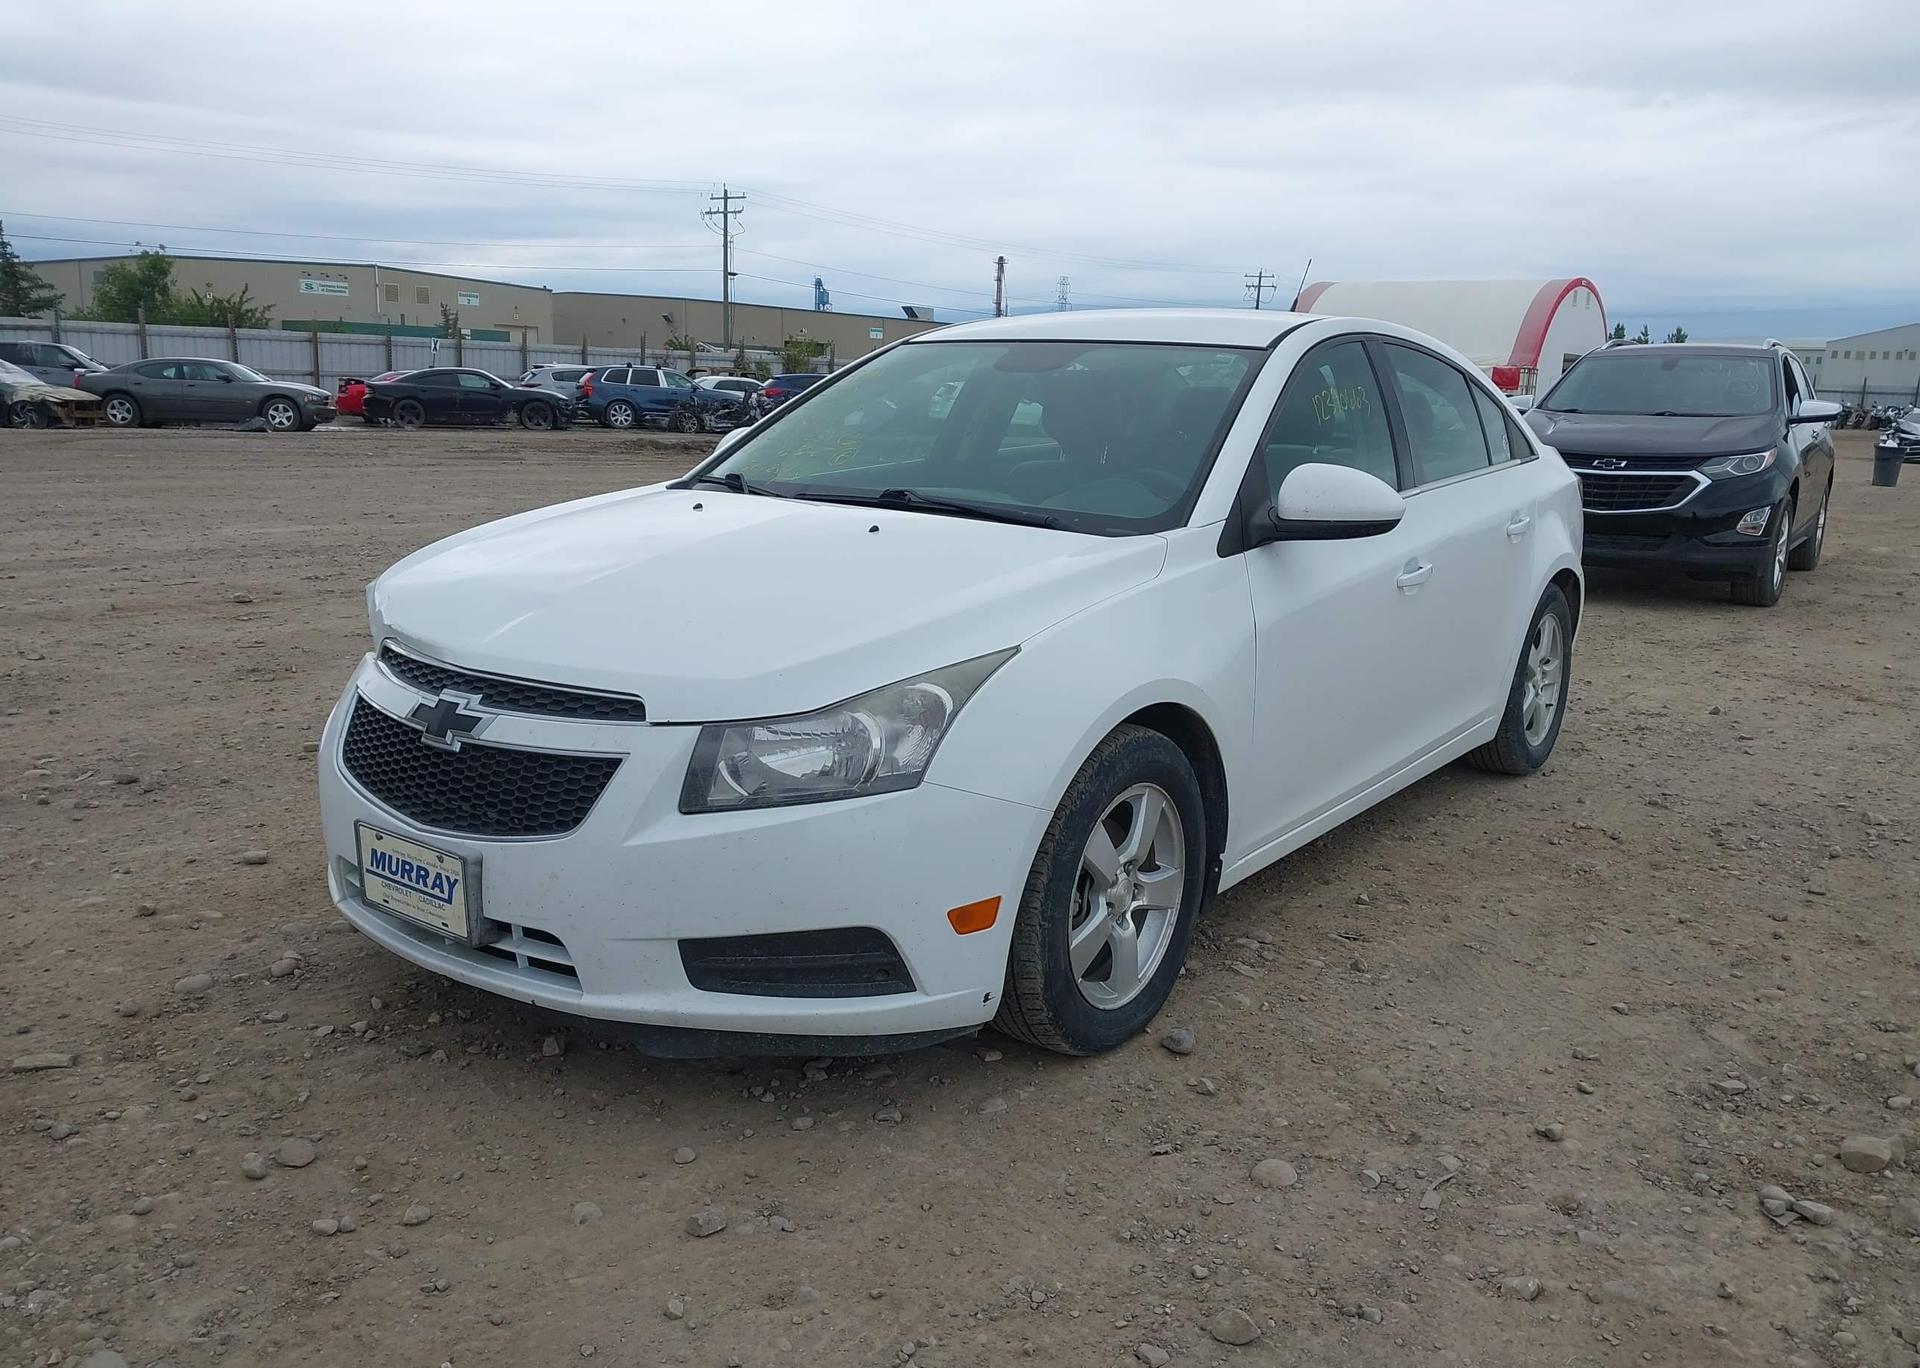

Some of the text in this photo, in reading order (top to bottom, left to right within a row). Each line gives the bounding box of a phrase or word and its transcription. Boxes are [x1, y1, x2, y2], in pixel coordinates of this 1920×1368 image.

[370, 848, 459, 905] MURRAY
[381, 881, 446, 911] CHEVROLET CADILLAC
